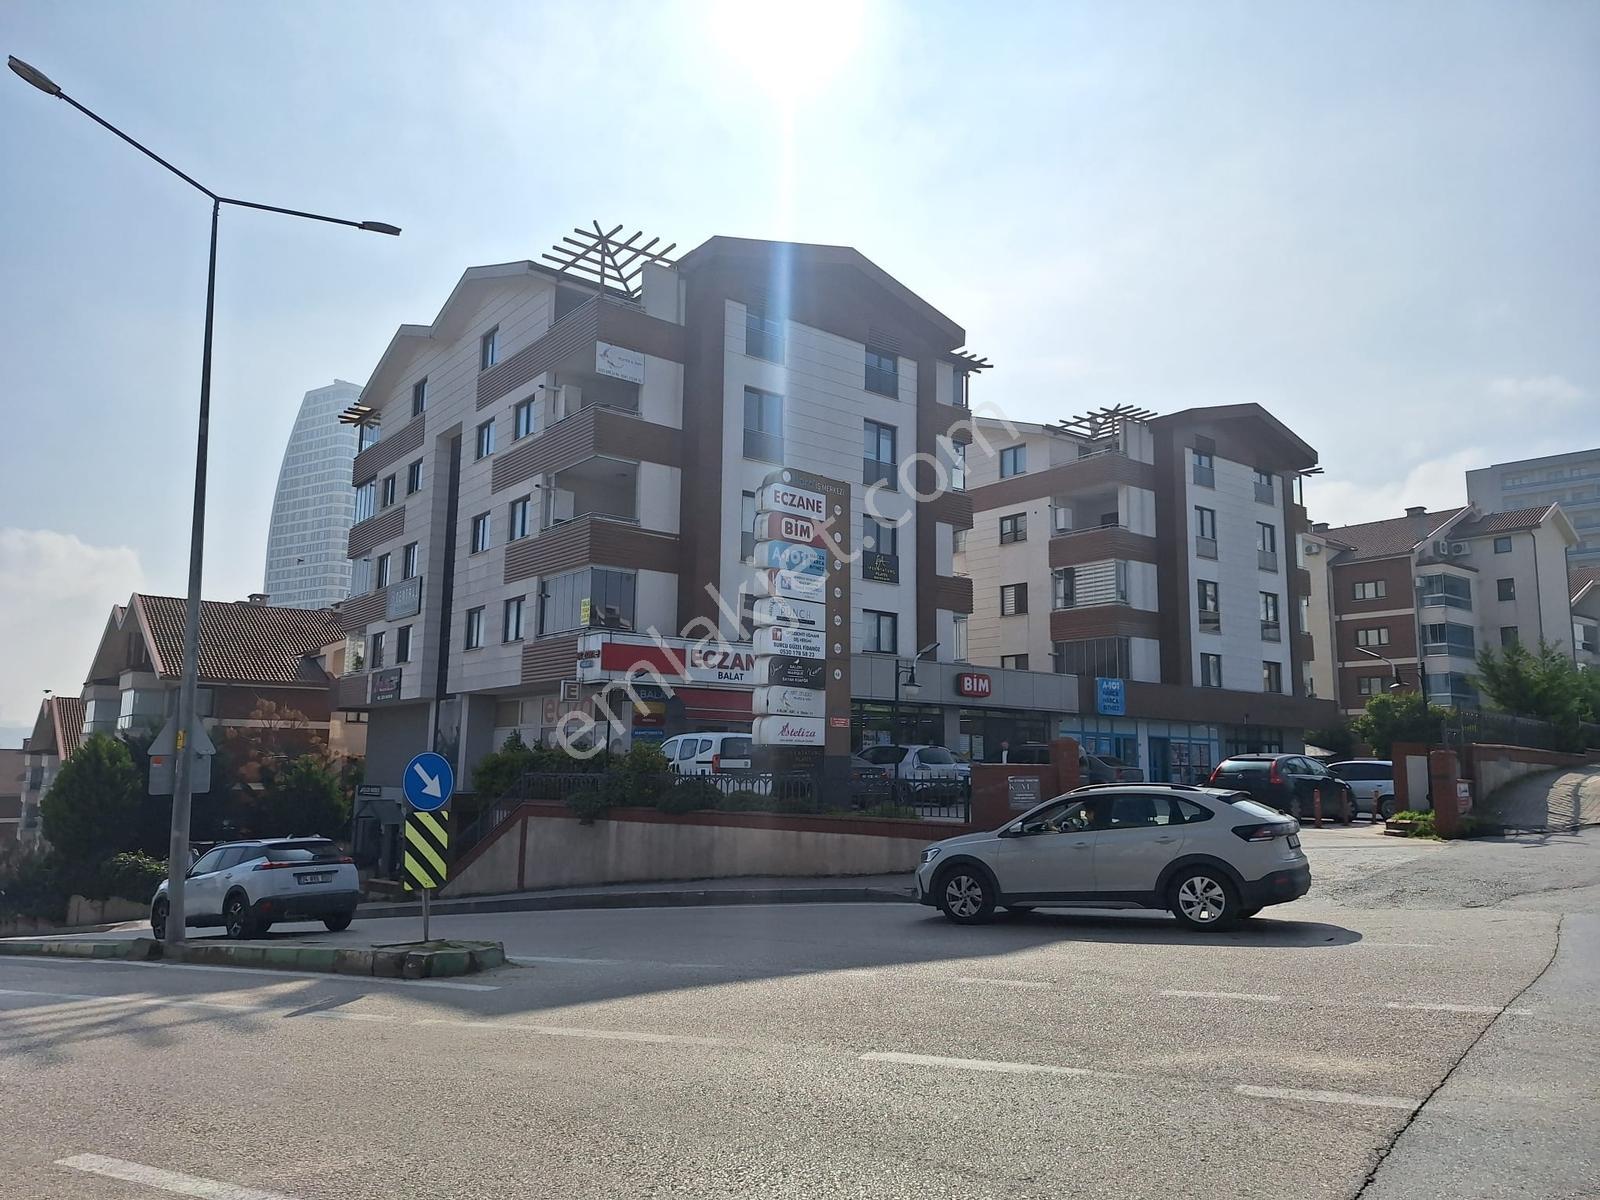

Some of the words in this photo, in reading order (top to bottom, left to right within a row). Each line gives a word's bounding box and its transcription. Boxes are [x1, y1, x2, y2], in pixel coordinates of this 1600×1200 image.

[773, 489, 823, 513] ECZANE
[784, 519, 811, 539] BİM
[781, 607, 811, 619] PUNCH
[691, 649, 754, 671] ECZAN
[718, 671, 744, 680] BALAT
[964, 674, 989, 693] BİM
